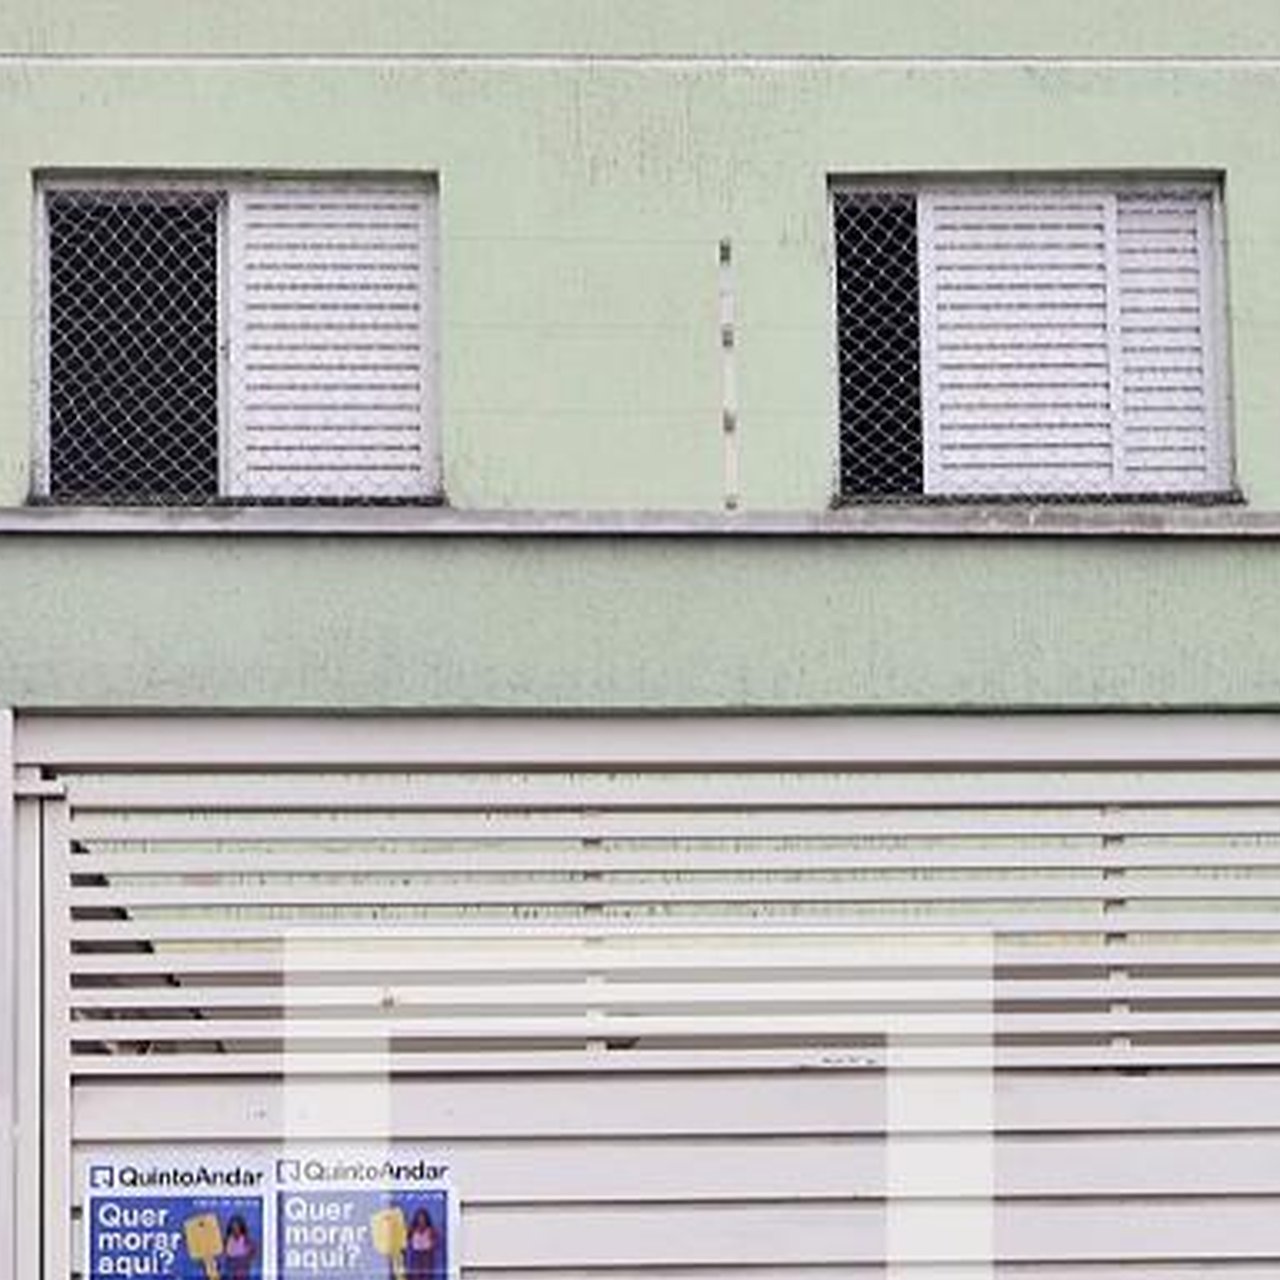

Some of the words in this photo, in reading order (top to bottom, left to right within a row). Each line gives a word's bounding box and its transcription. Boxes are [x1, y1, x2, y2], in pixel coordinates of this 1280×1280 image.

[118, 1165, 264, 1188] QuintoAndar
[303, 1160, 450, 1182] QuintoAndar
[98, 1202, 168, 1228] Quer
[284, 1197, 354, 1221] Quer
[98, 1230, 181, 1251] morar
[284, 1224, 366, 1245] morar
[98, 1252, 175, 1277] aqui?
[284, 1246, 361, 1270] aqui?
